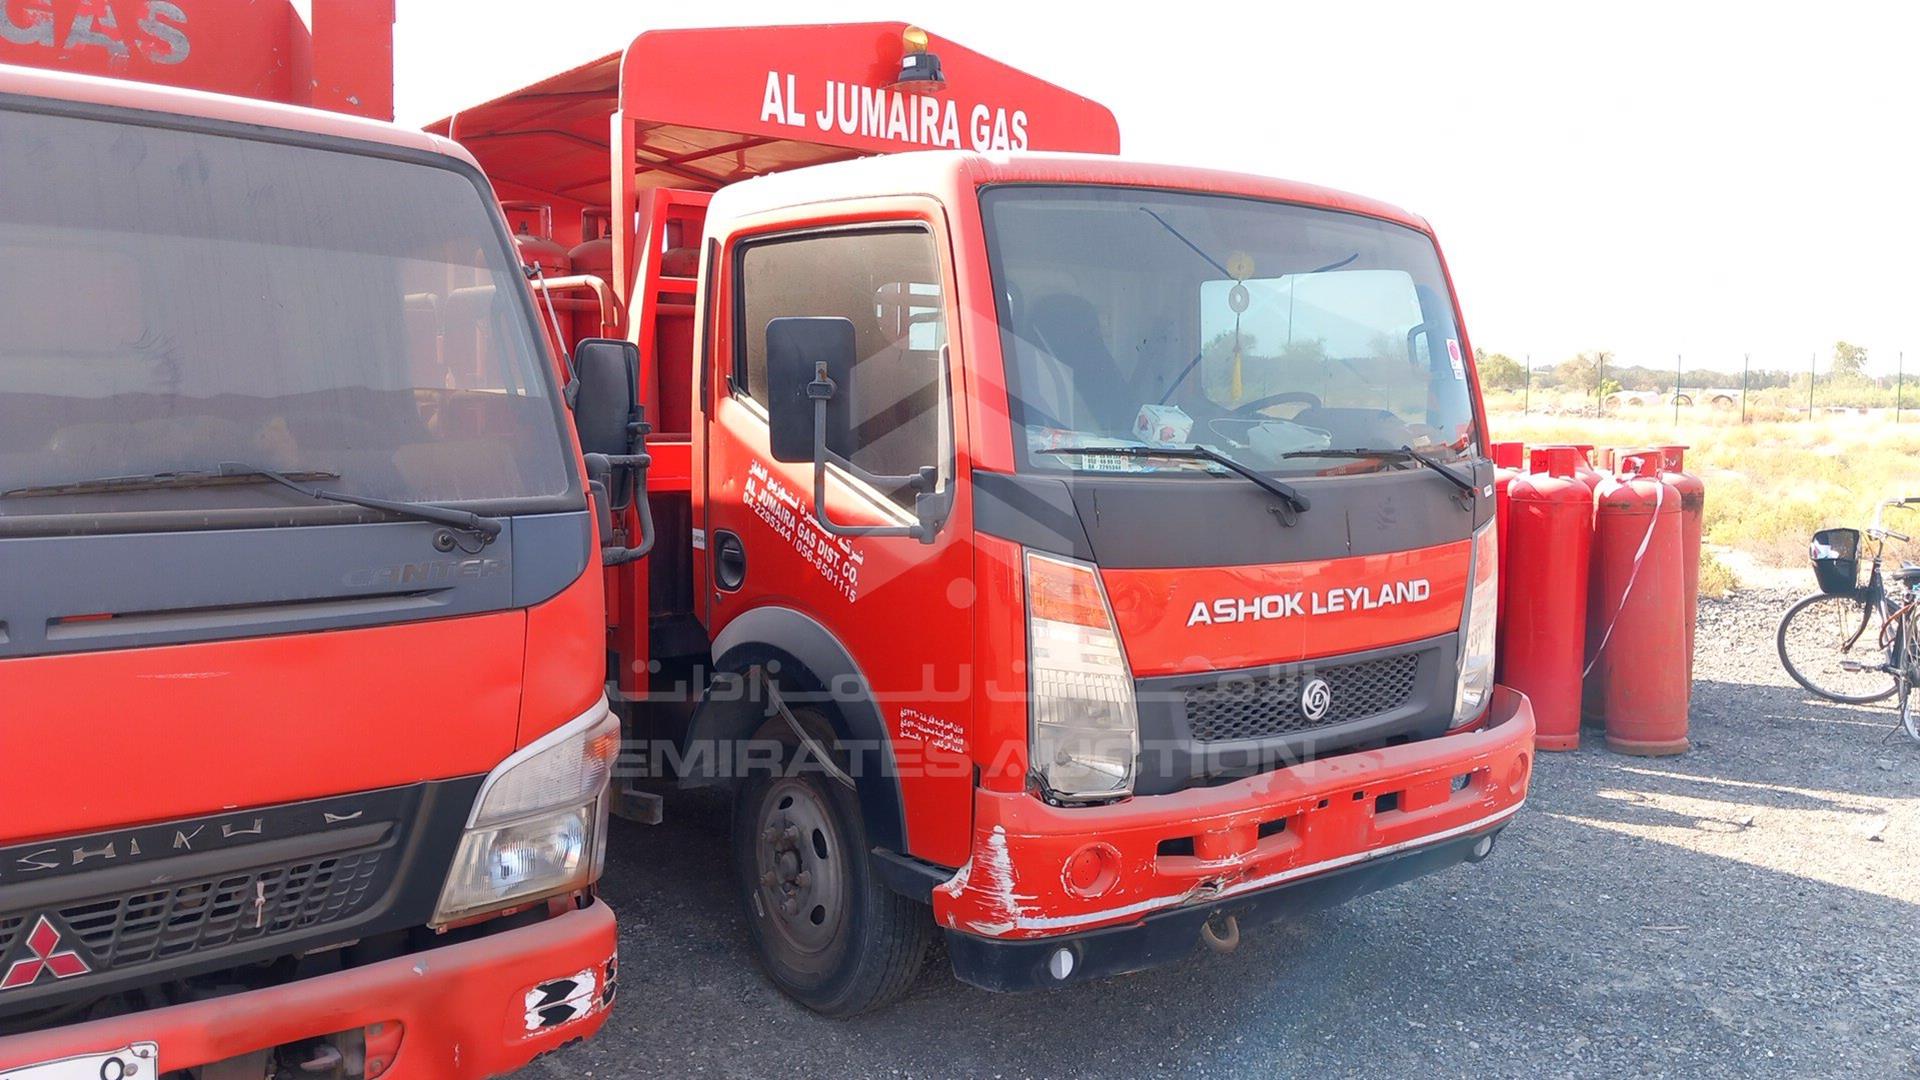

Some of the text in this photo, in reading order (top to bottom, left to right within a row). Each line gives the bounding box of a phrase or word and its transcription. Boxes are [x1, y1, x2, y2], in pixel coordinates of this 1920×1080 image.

[0, 0, 190, 65] GAS
[760, 71, 1029, 151] AL JUMAIRA GAS
[743, 491, 791, 542] 04-2295344
[745, 478, 858, 586] AL JUMAIRA GAS DIST. CO.
[1186, 578, 1430, 628] ASHOK LEYLAND
